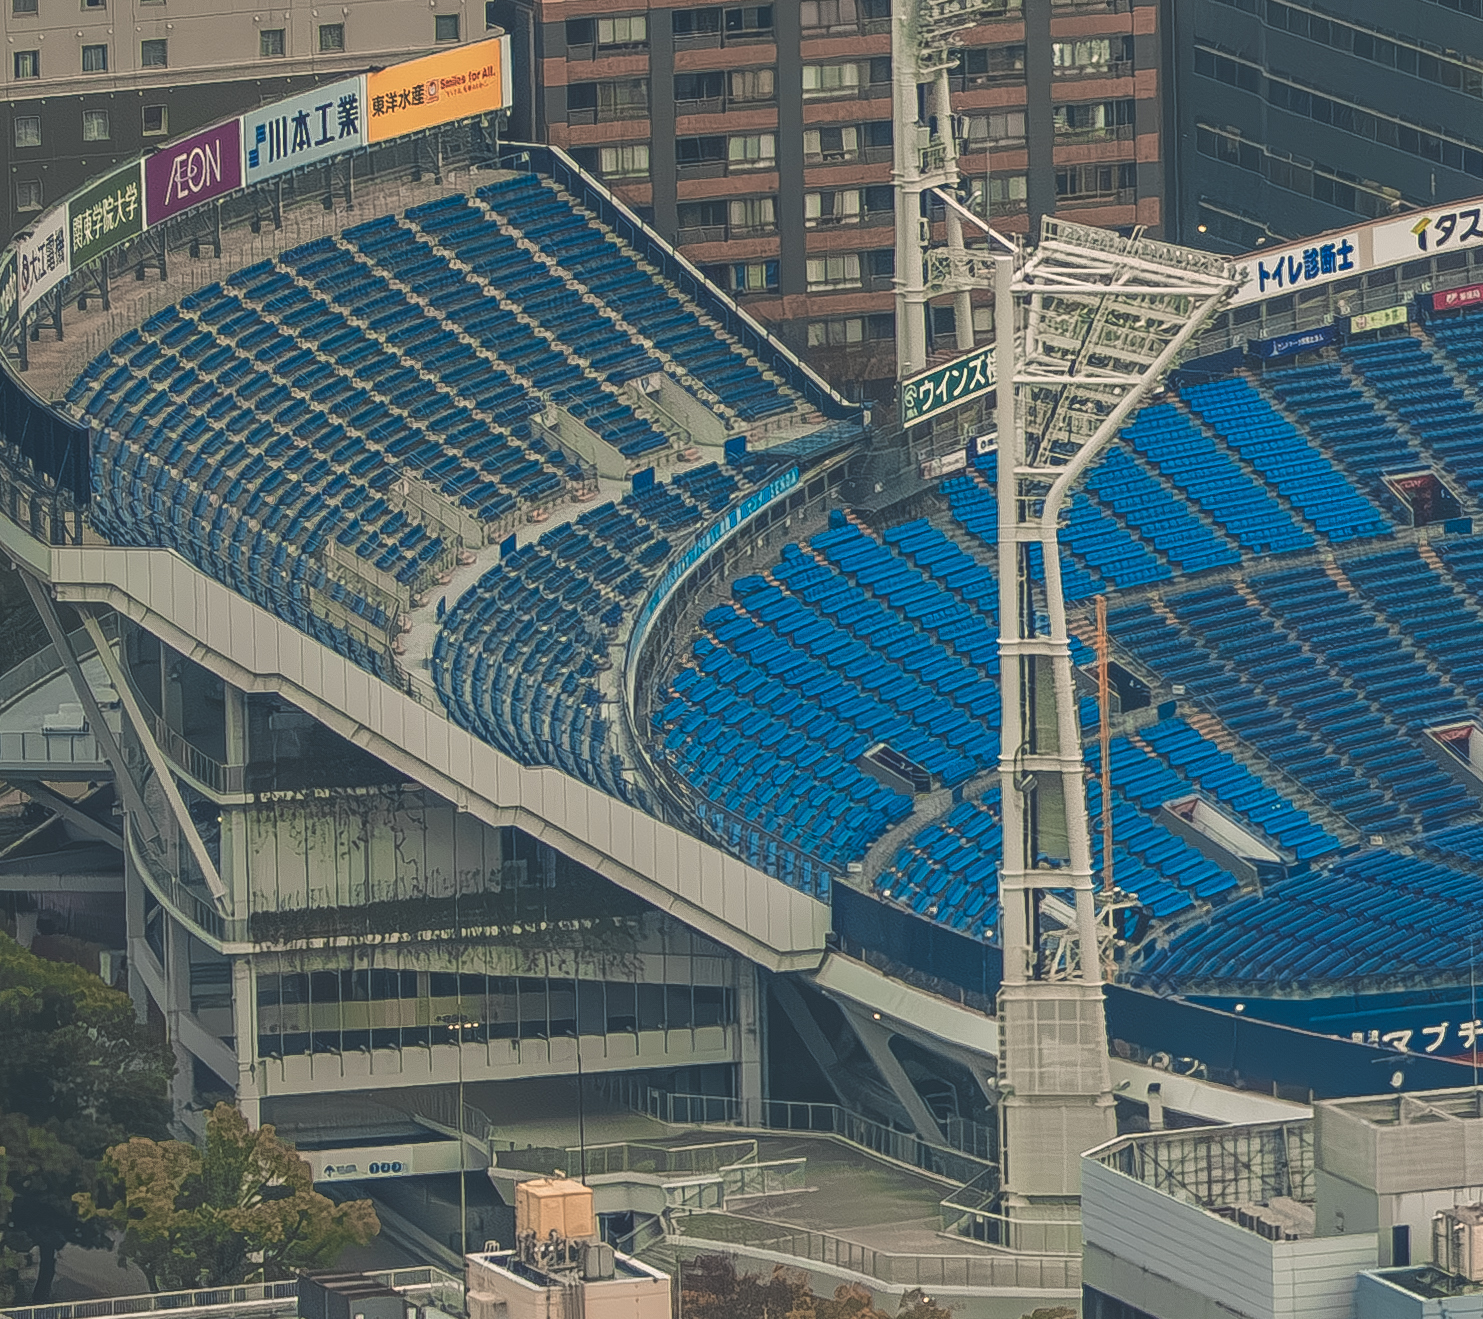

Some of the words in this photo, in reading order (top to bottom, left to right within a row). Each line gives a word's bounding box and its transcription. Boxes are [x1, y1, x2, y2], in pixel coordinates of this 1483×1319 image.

[269, 92, 360, 164] 川本工業
[371, 83, 425, 118] 東洋水産
[72, 182, 139, 253] 関東学院大学
[1257, 239, 1354, 293] トイレ診断士
